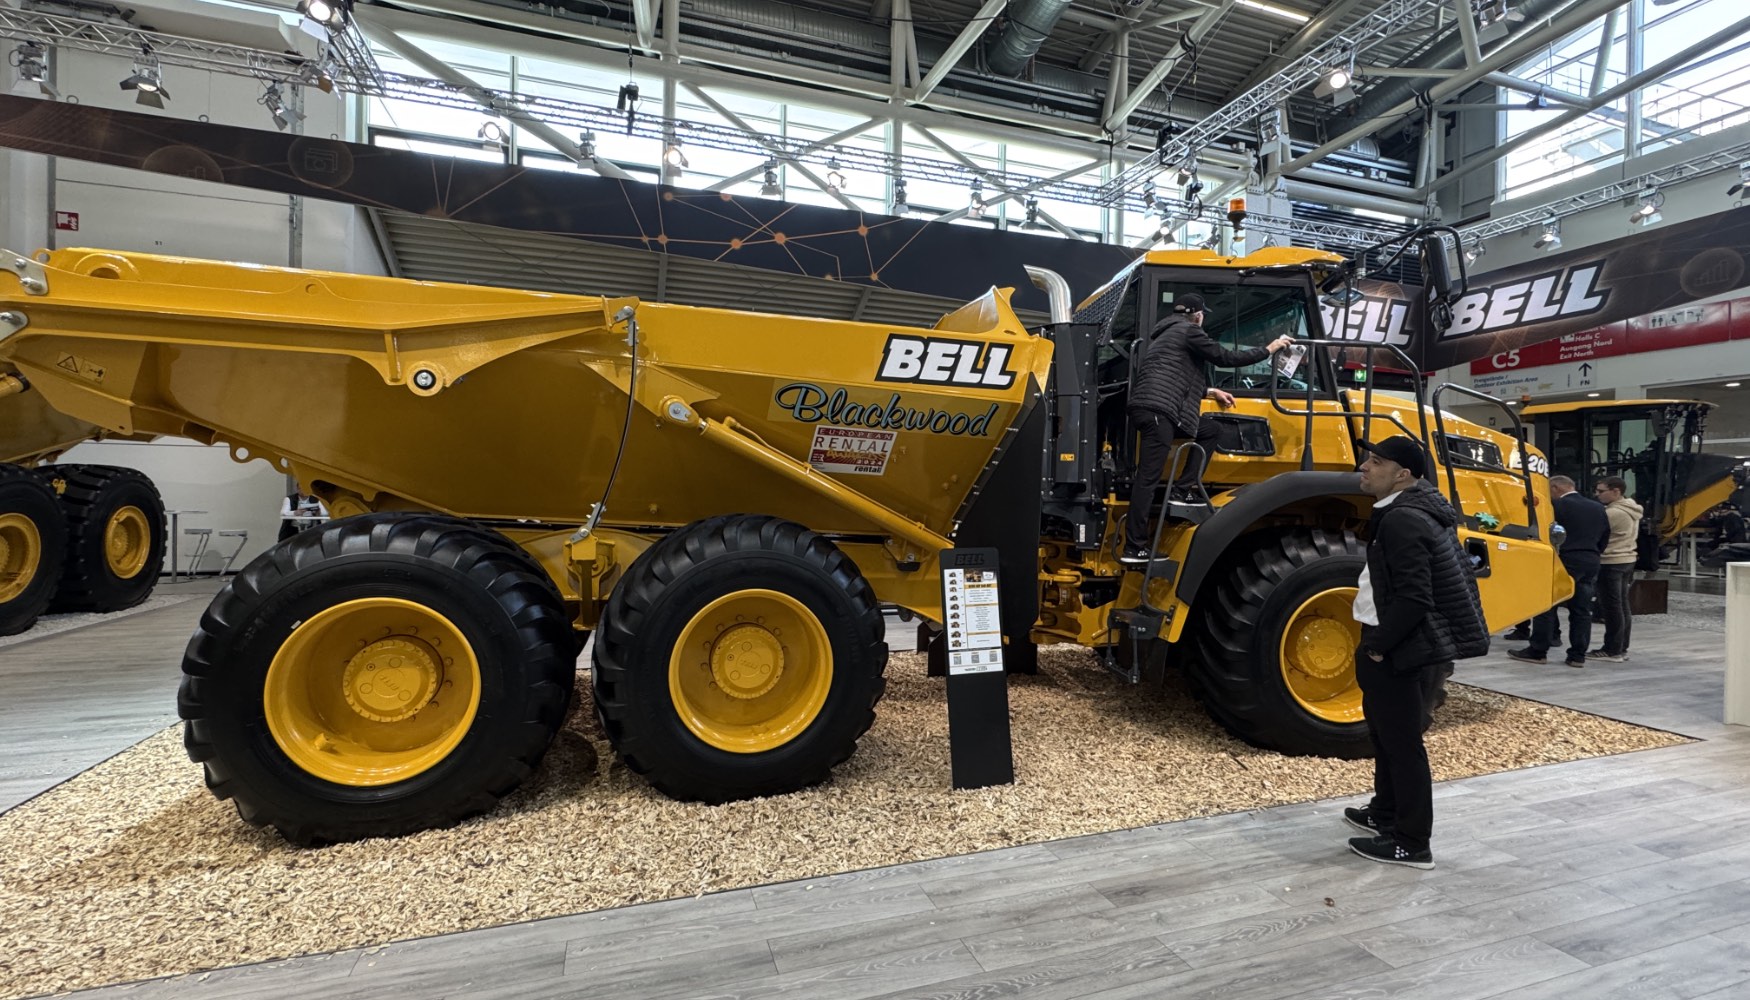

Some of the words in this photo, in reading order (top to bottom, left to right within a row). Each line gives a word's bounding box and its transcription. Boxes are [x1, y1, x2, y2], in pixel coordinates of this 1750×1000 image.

[1442, 264, 1605, 338] BELL
[1593, 338, 1613, 347] Nord
[878, 335, 1014, 388] BELL
[1490, 350, 1520, 369] C5
[1573, 350, 1594, 358] North
[774, 382, 1000, 437] Blackwood
[819, 428, 892, 440] EUROPEAN
[813, 436, 889, 453] RENTAL
